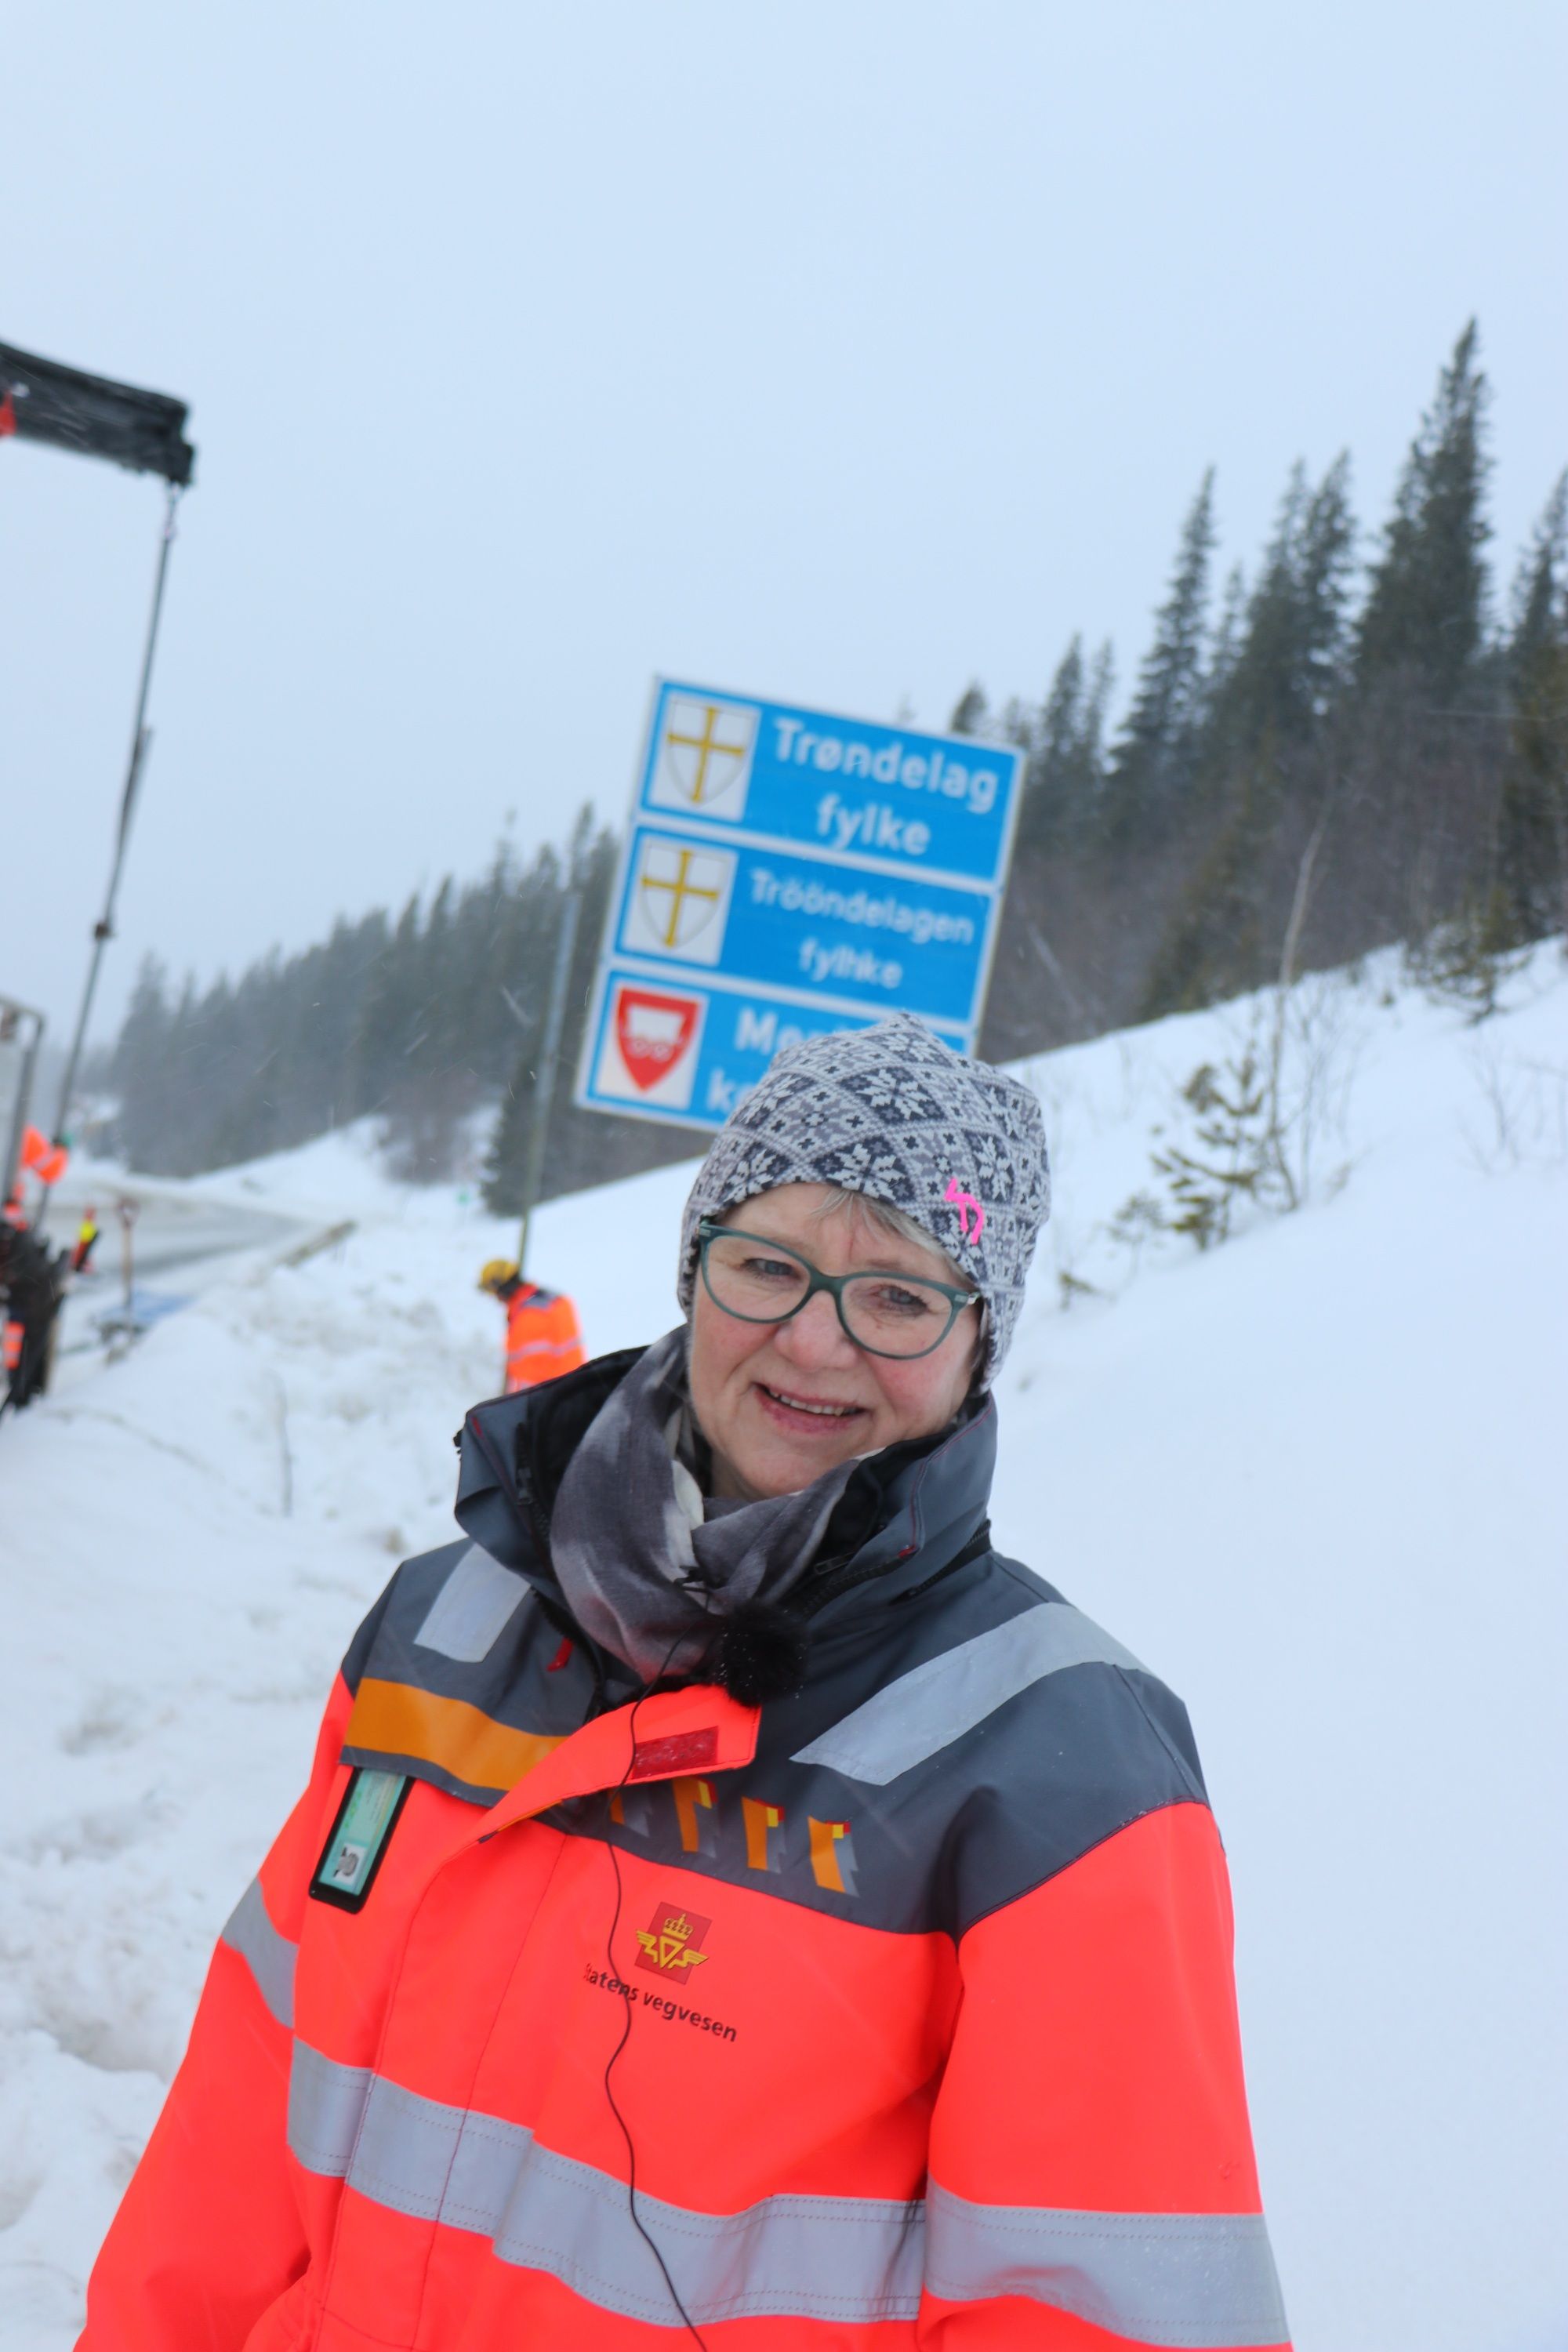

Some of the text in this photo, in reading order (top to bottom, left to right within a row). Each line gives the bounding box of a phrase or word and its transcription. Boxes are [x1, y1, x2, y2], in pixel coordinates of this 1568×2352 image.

[774, 717, 998, 815] Trøndelag
[816, 791, 931, 855] fylke
[750, 868, 975, 946] Trööndelagen
[798, 938, 903, 989] fylhke
[584, 1962, 737, 2042] atens vegvesen
